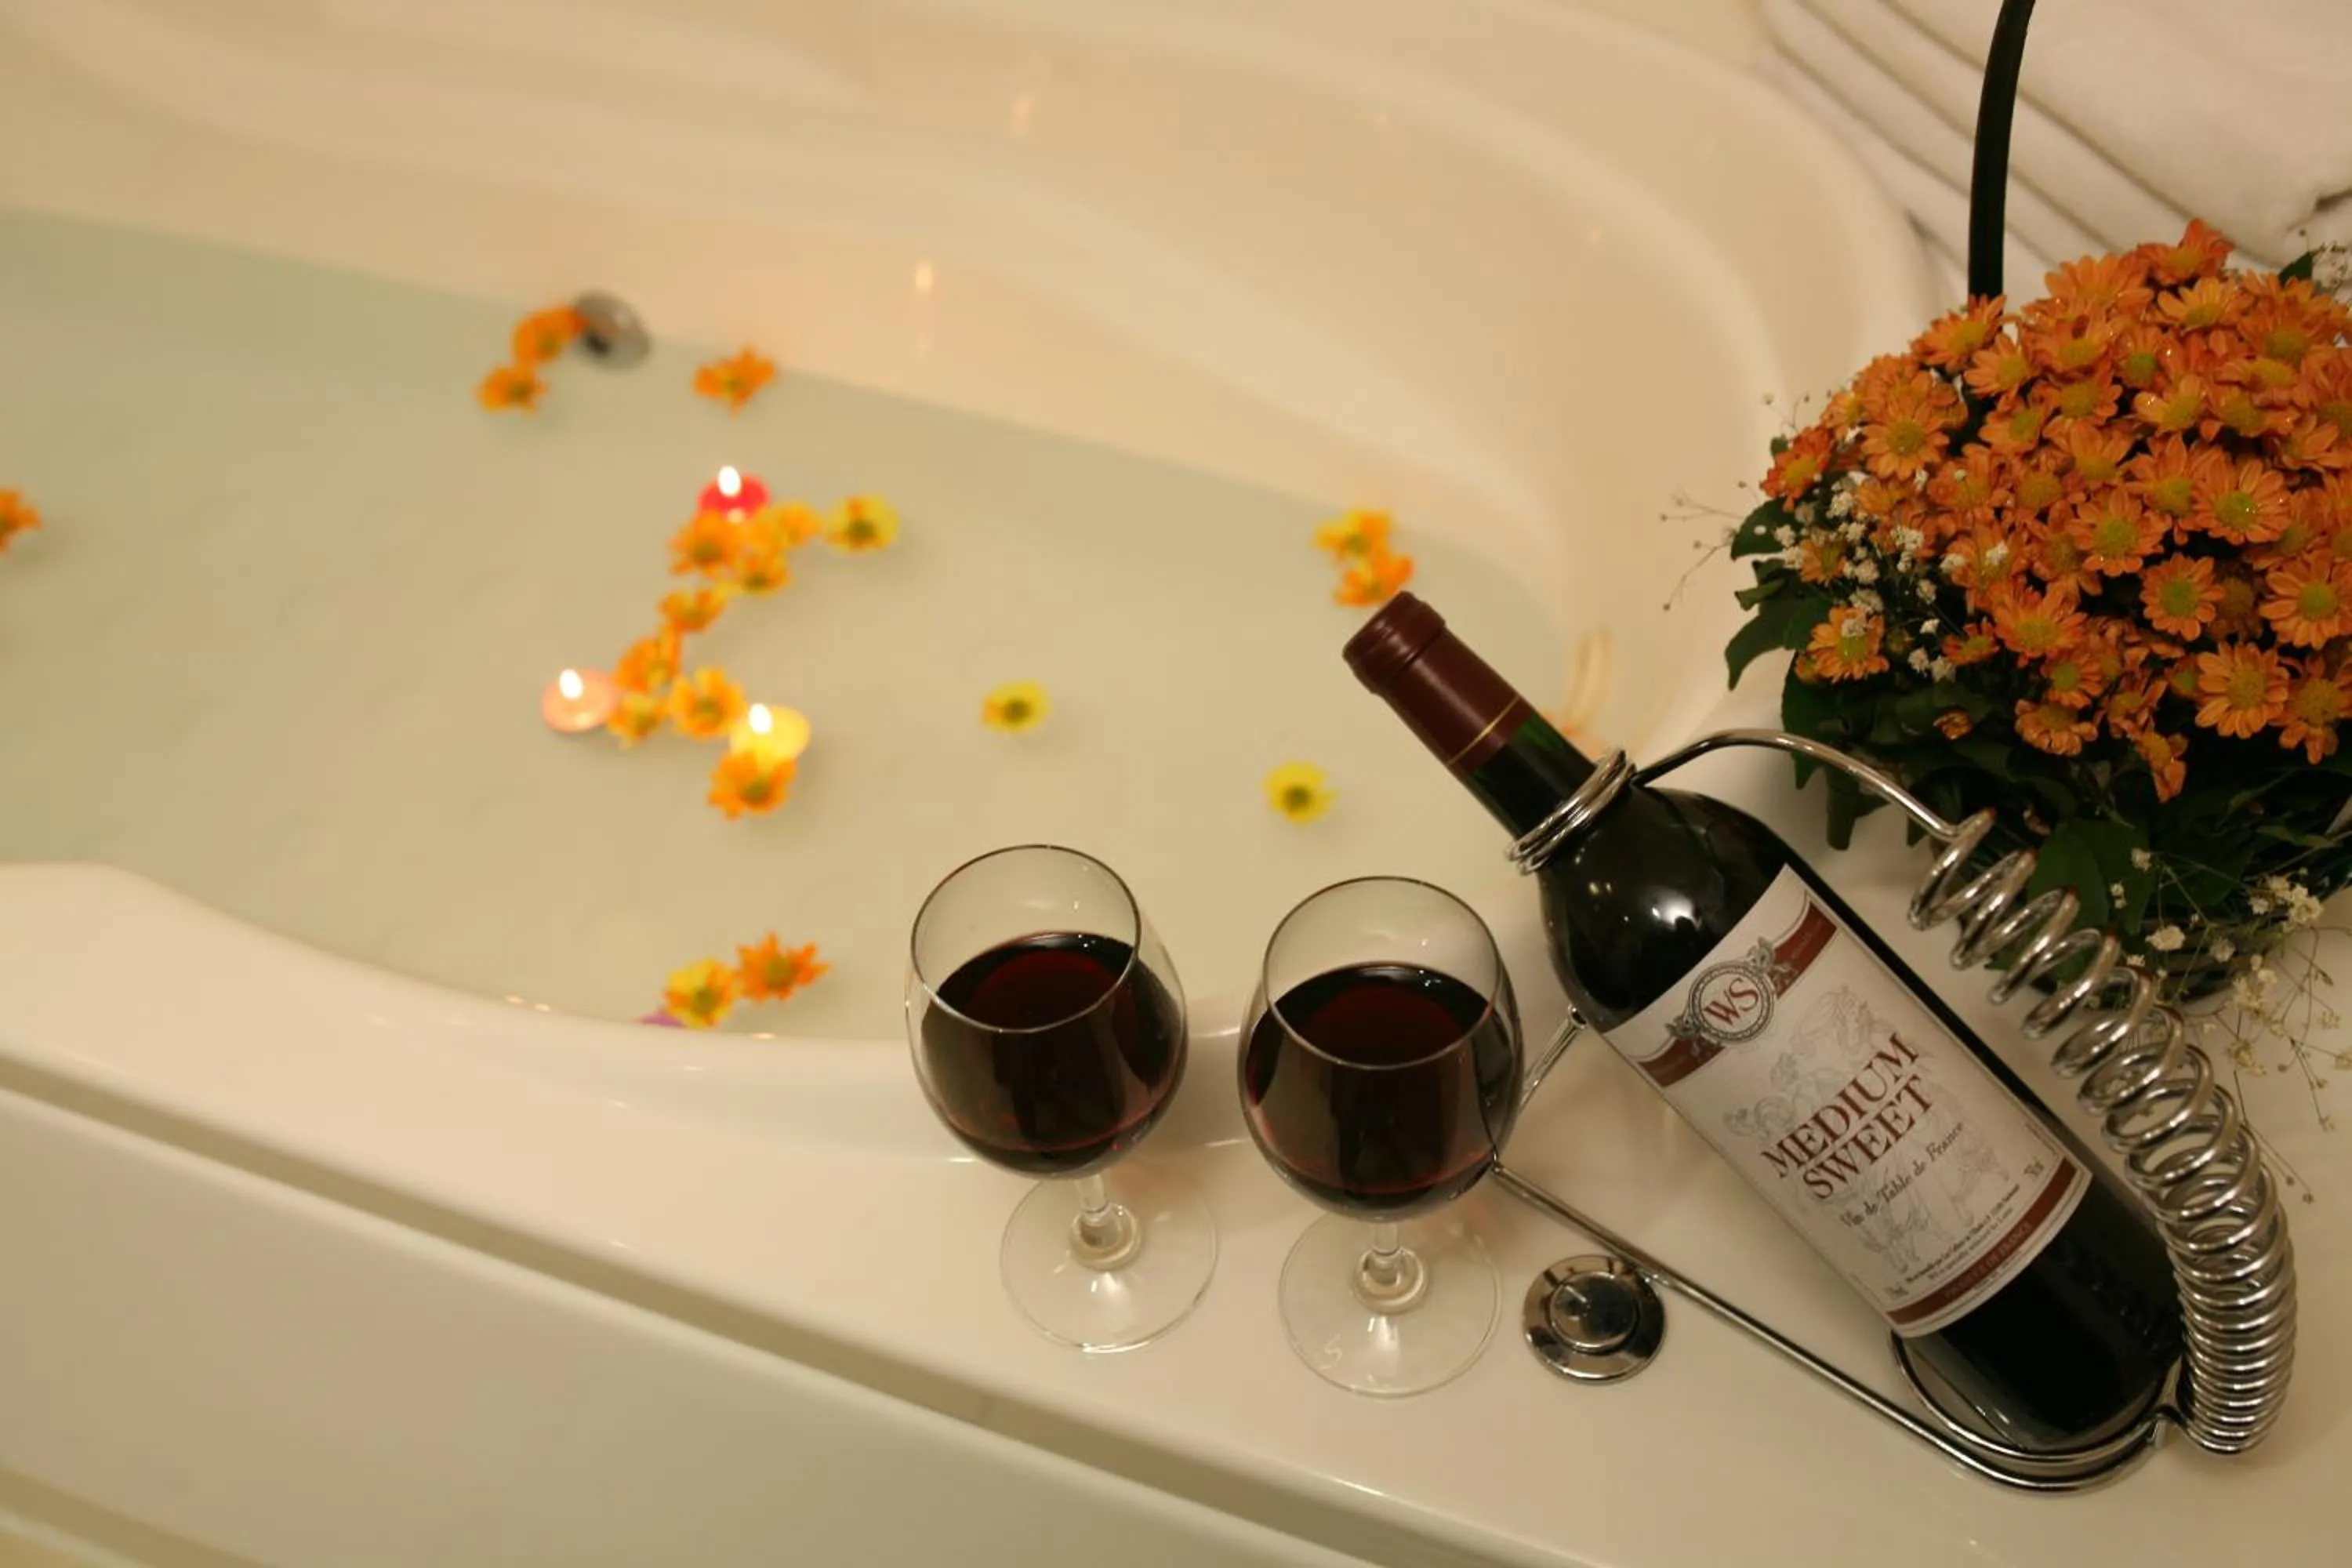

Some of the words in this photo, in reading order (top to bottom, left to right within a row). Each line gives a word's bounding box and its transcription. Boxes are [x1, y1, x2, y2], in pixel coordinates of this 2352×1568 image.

[1704, 976, 1759, 1025] WS
[1760, 1032, 1920, 1178] MEDIUM
[1802, 1073, 1933, 1200] SWEET
[1863, 1201, 1878, 1216] de
[1876, 1173, 1914, 1204] Table
[1911, 1160, 1927, 1176] de
[1925, 1121, 1964, 1162] France
